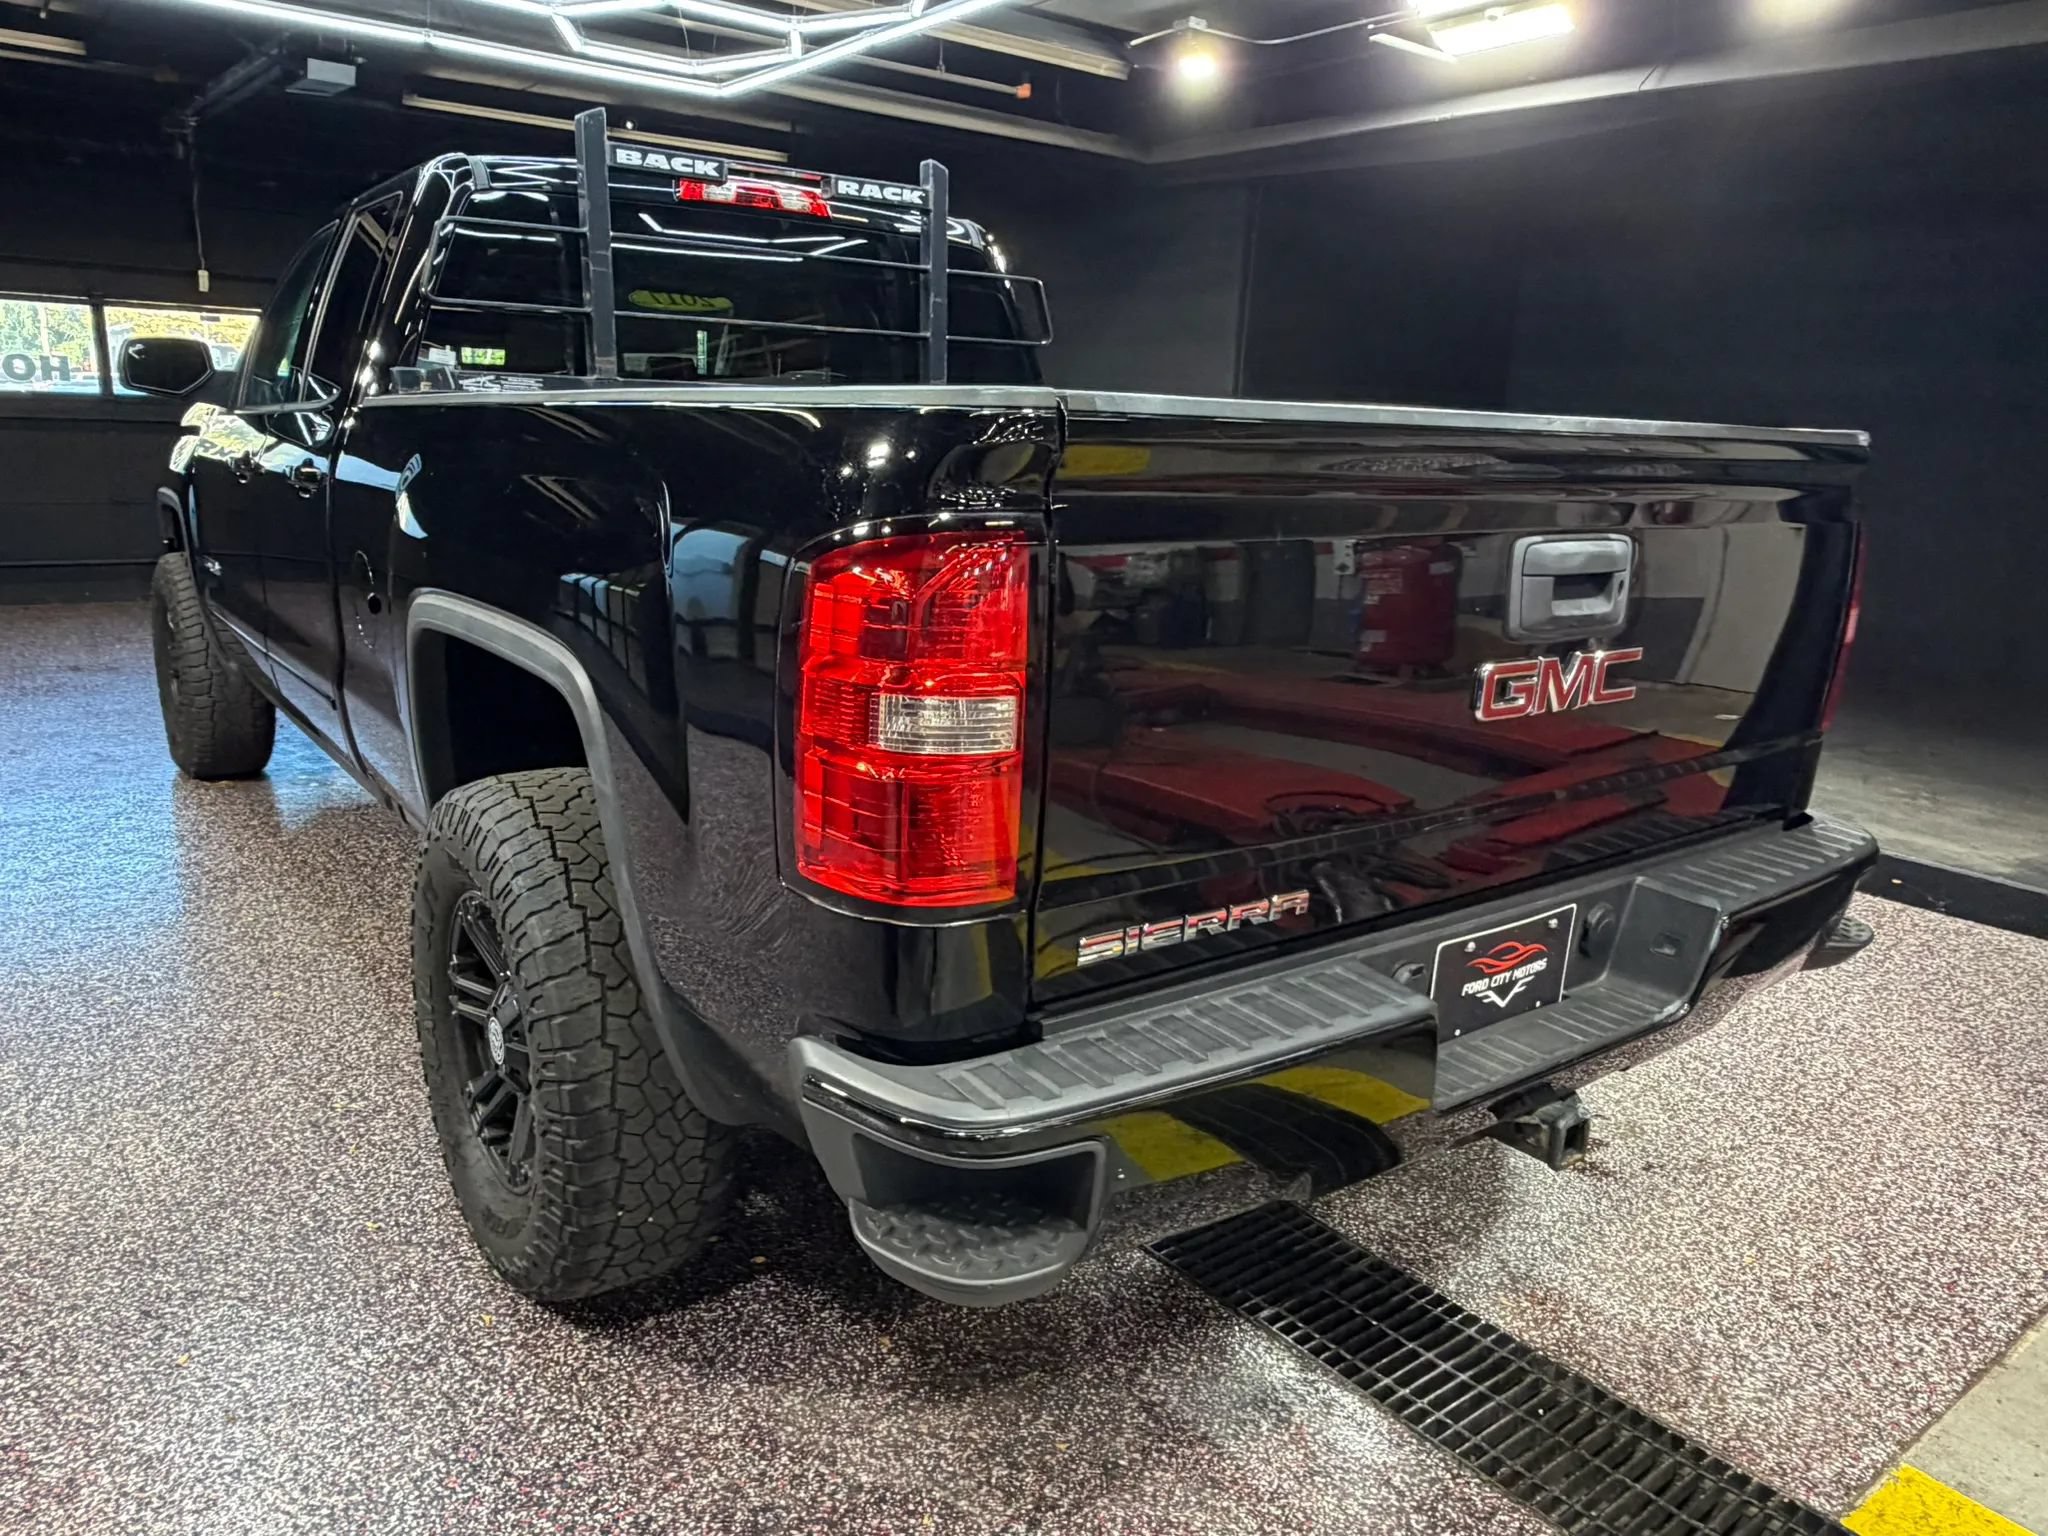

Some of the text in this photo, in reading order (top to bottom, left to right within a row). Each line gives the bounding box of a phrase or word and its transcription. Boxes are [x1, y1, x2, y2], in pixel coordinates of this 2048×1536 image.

[615, 148, 720, 177] BACK
[837, 180, 924, 205] RACK
[1473, 647, 1644, 721] GMC
[1076, 889, 1310, 967] SIERRA
[1461, 957, 1548, 997] FORD CITY MOTORS
